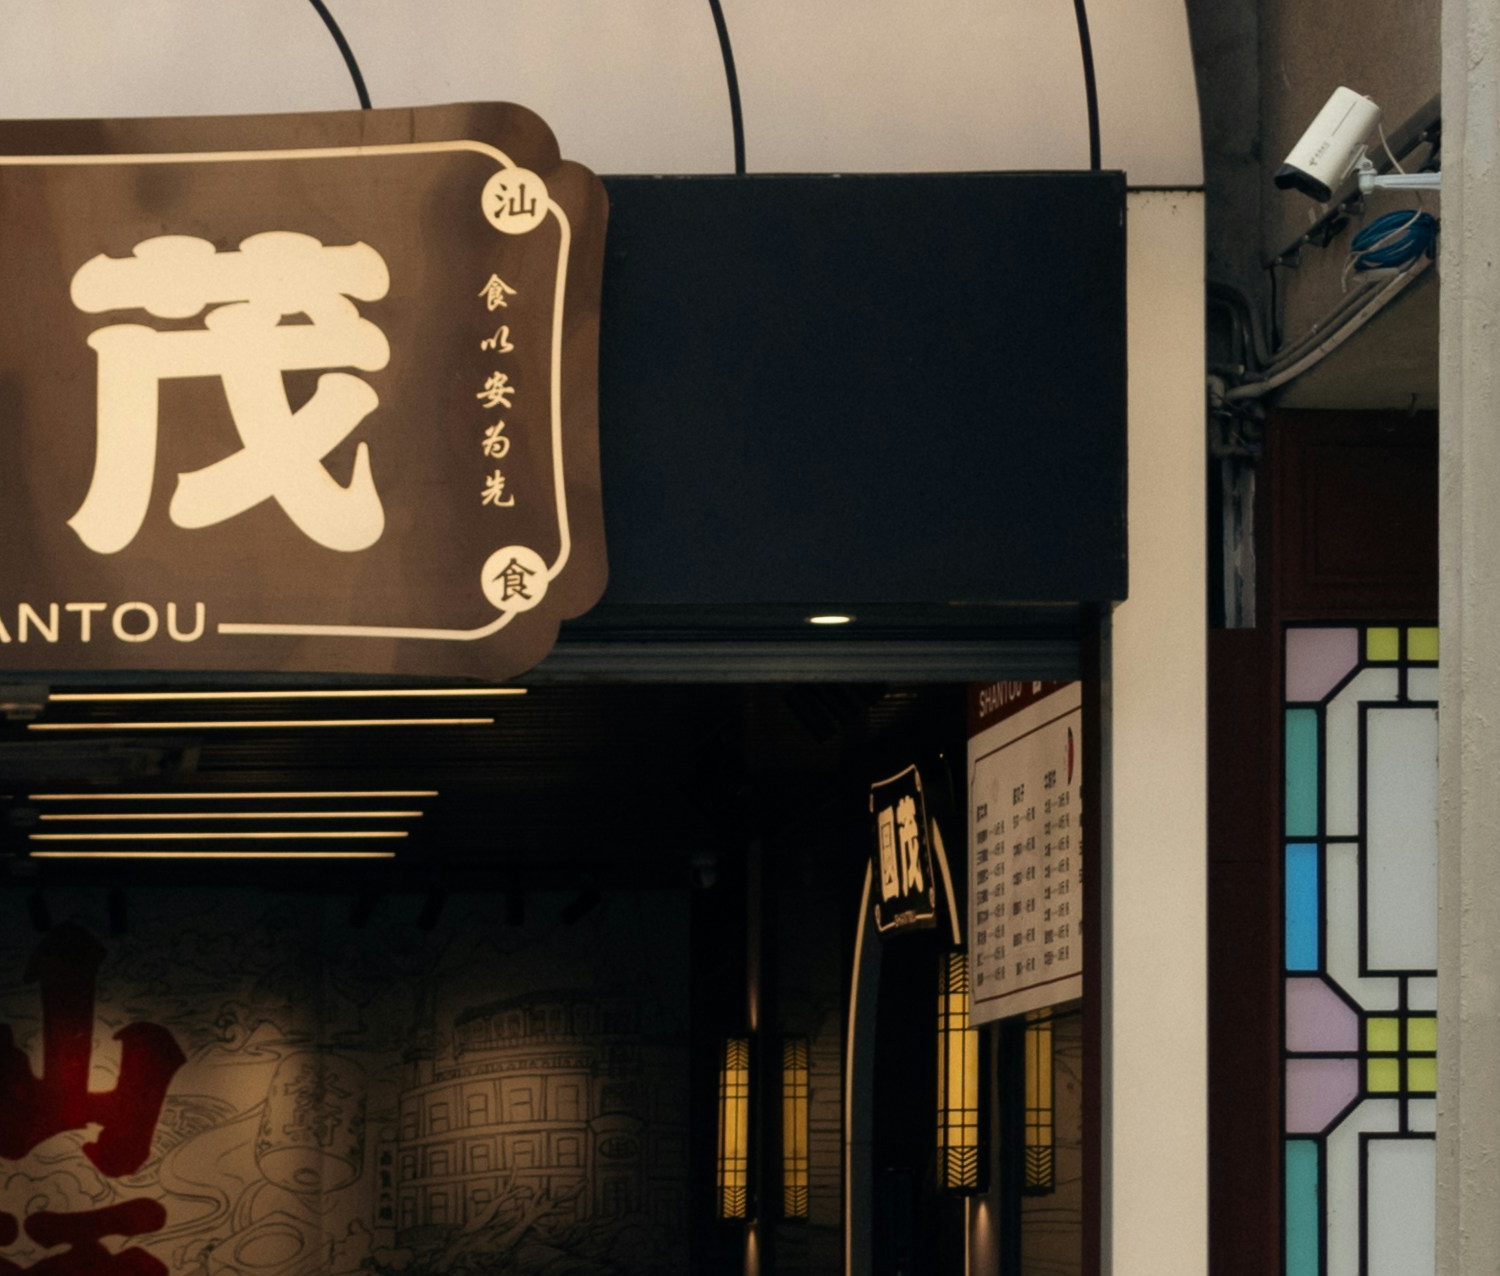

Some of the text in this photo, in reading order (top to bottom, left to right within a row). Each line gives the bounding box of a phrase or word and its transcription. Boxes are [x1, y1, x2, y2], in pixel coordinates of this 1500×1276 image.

[494, 180, 538, 221] 汕
[476, 273, 518, 508] 食以安为先
[492, 557, 537, 604] 食
